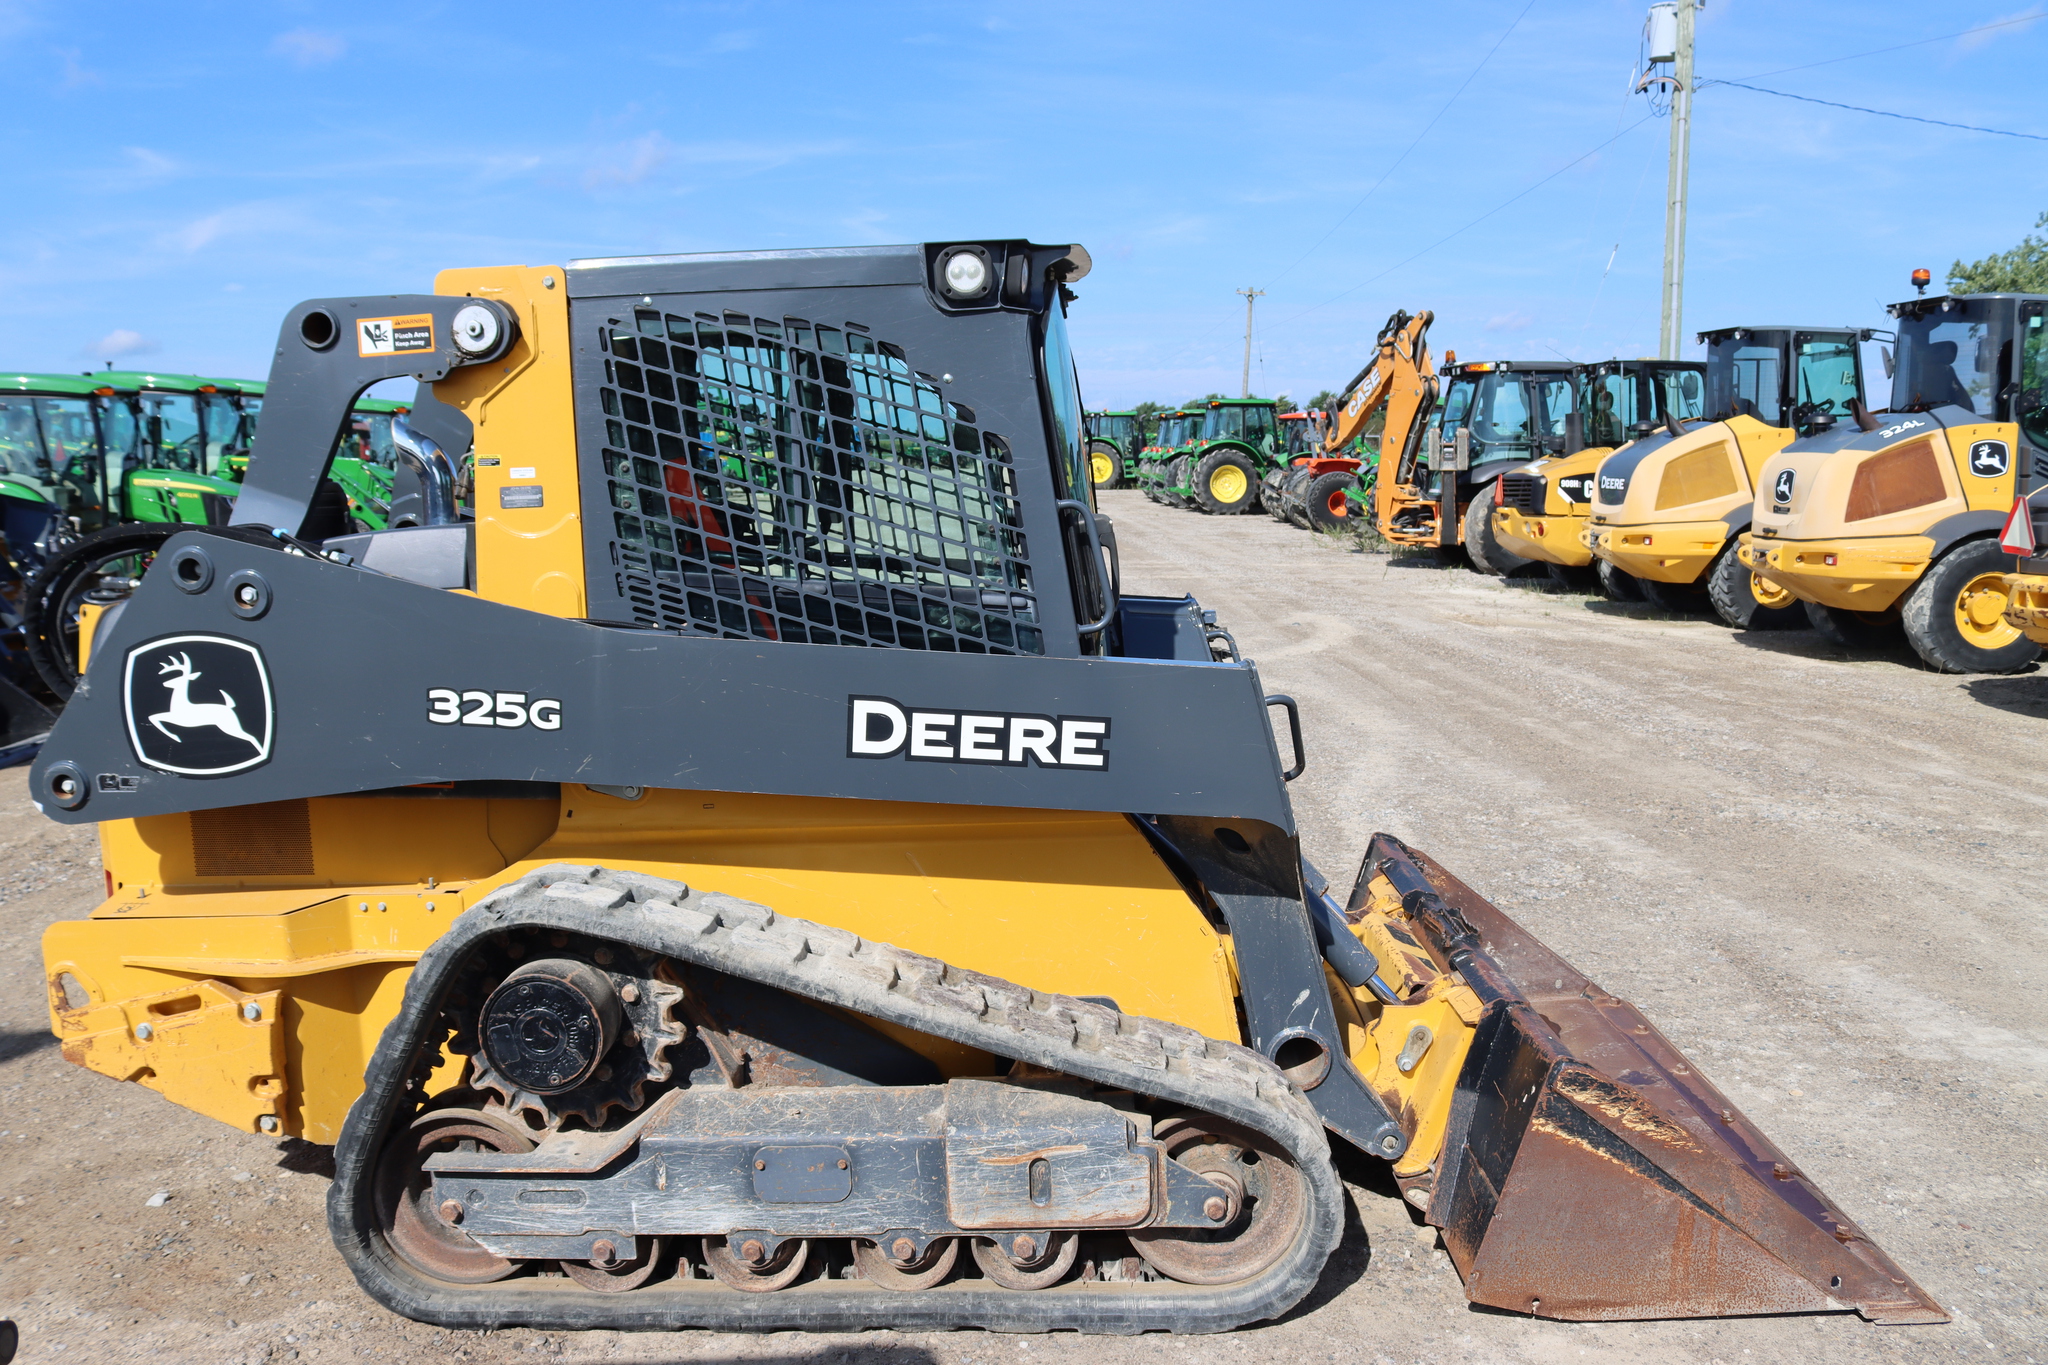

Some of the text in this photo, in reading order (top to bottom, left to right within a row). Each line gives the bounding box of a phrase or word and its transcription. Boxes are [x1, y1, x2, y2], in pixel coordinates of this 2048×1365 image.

[1348, 366, 1381, 418] CASE
[1879, 420, 1925, 439] 324L
[1601, 476, 1625, 490] DEERE
[428, 689, 561, 730] 325G
[851, 699, 1107, 767] DEERE
